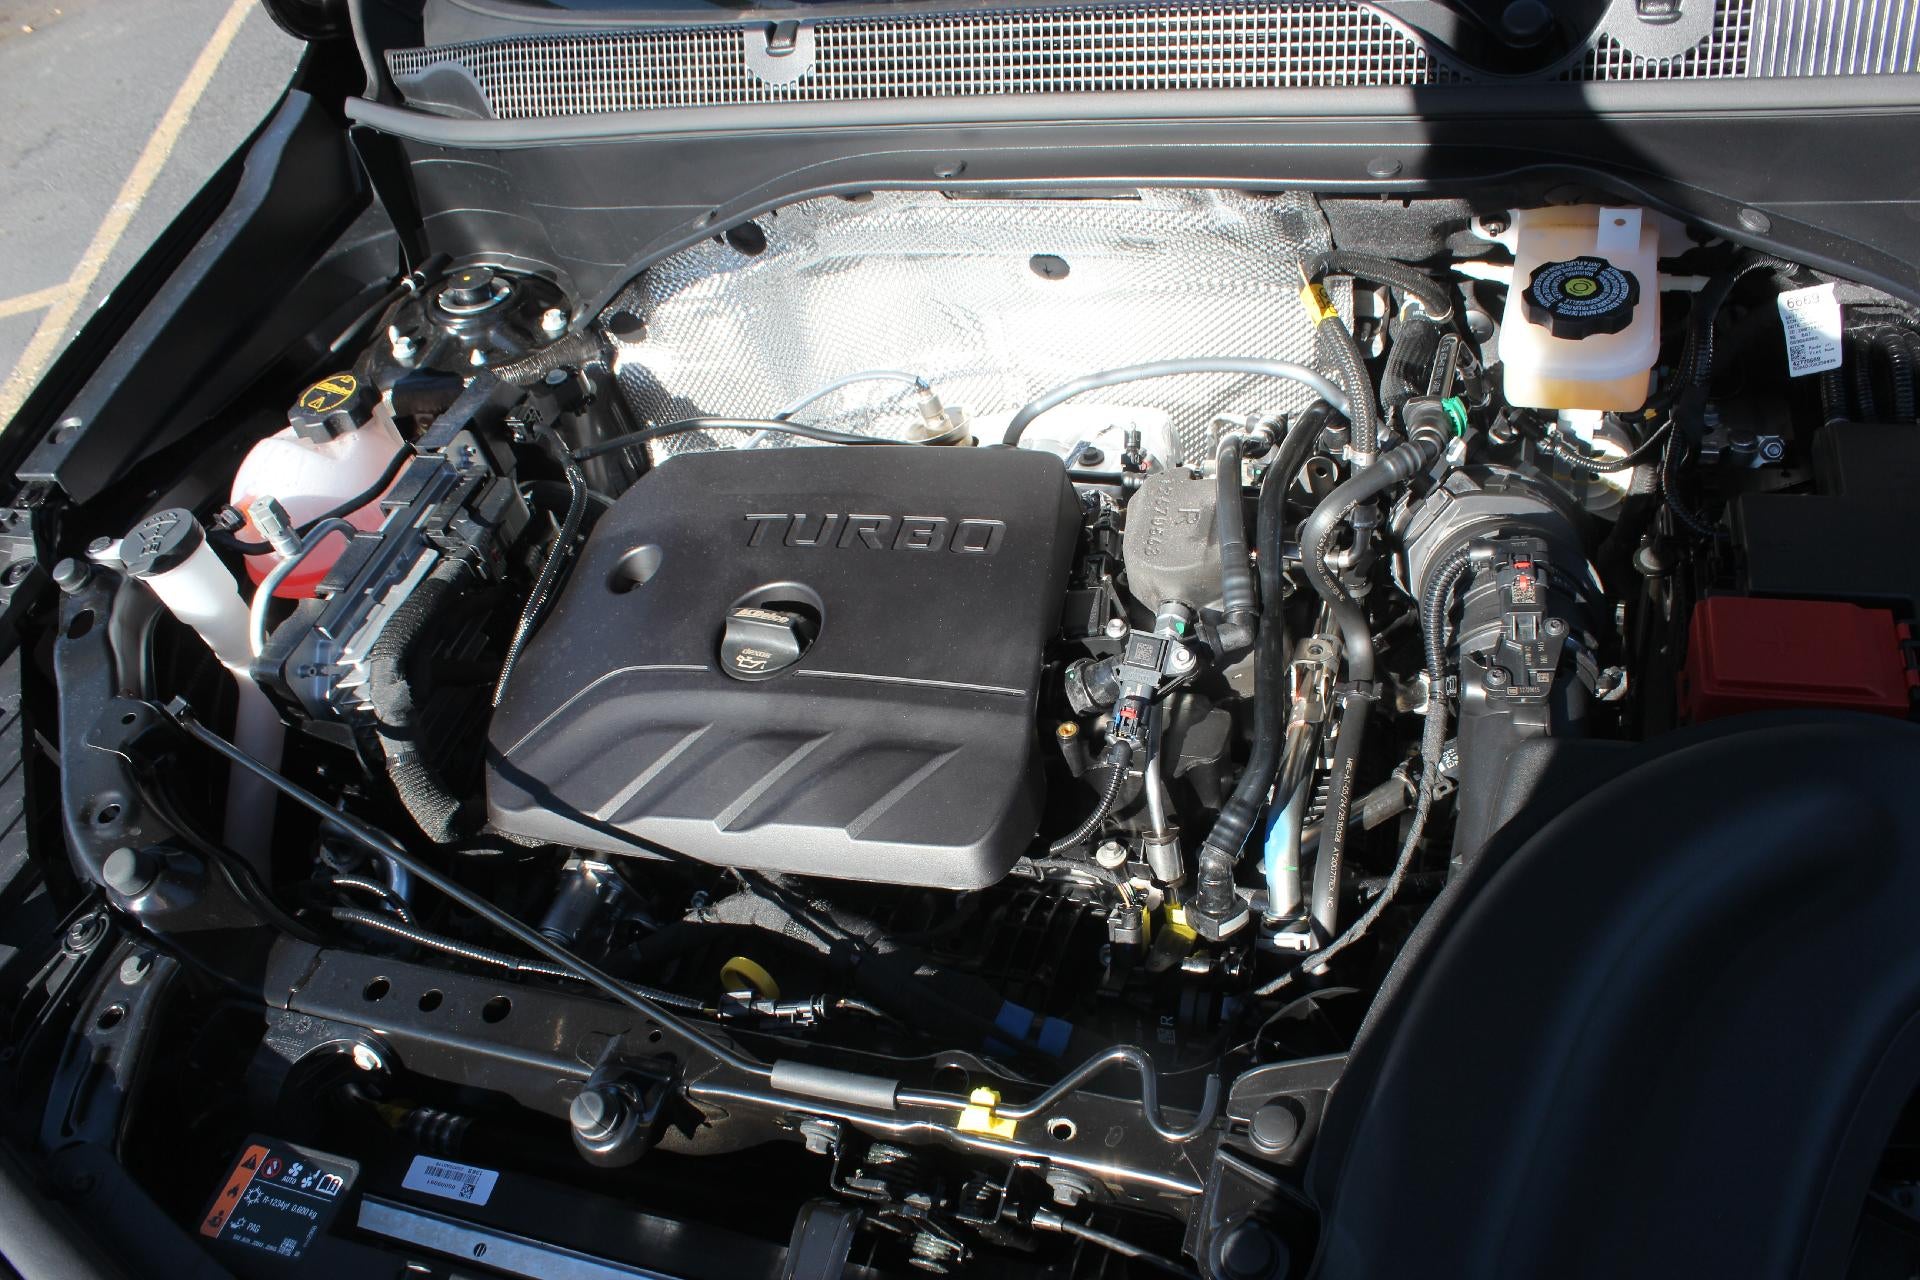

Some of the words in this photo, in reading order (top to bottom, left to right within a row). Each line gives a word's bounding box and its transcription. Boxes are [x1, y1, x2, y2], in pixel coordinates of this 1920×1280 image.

[744, 513, 1007, 554] TURBO
[733, 609, 790, 624] ACDelco
[742, 648, 773, 660] dexos
[281, 1175, 297, 1185] AUTO
[246, 1222, 261, 1233] PAG
